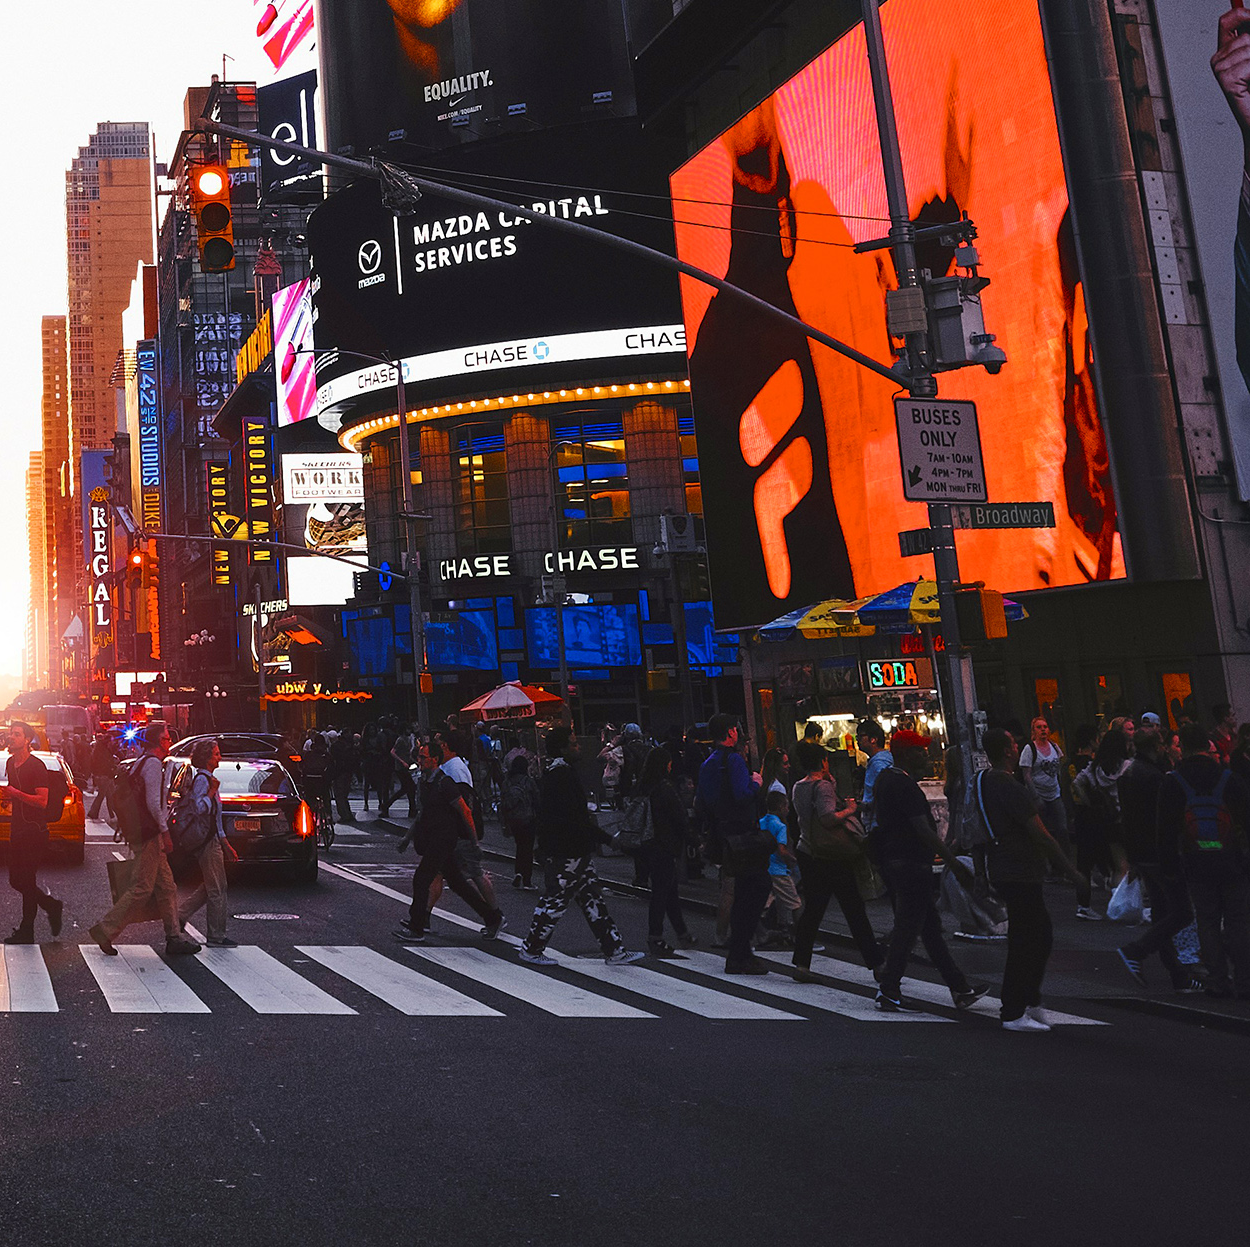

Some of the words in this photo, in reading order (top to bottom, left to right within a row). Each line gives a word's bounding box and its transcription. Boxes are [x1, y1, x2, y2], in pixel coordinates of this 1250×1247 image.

[413, 211, 490, 245] MAZDA
[414, 235, 517, 273] SERVICES
[464, 345, 528, 367] CHASE
[358, 367, 397, 389] CHASE
[911, 408, 962, 426] BUSES
[920, 430, 957, 447] ONLY
[141, 426, 160, 486] STUDIOS
[247, 422, 268, 508] VICTORY
[294, 471, 360, 485] WORK
[926, 482, 947, 492] MON
[950, 485, 966, 493] THRU
[967, 483, 982, 493] FRI
[143, 493, 161, 528] DUKE
[976, 505, 1049, 527] Broadway
[91, 506, 110, 626] REGAL
[215, 550, 230, 585] NEW
[440, 555, 511, 581] CHASE
[545, 548, 639, 573] CHASE
[243, 599, 288, 616] SKCHERS
[870, 663, 918, 687] SODA
